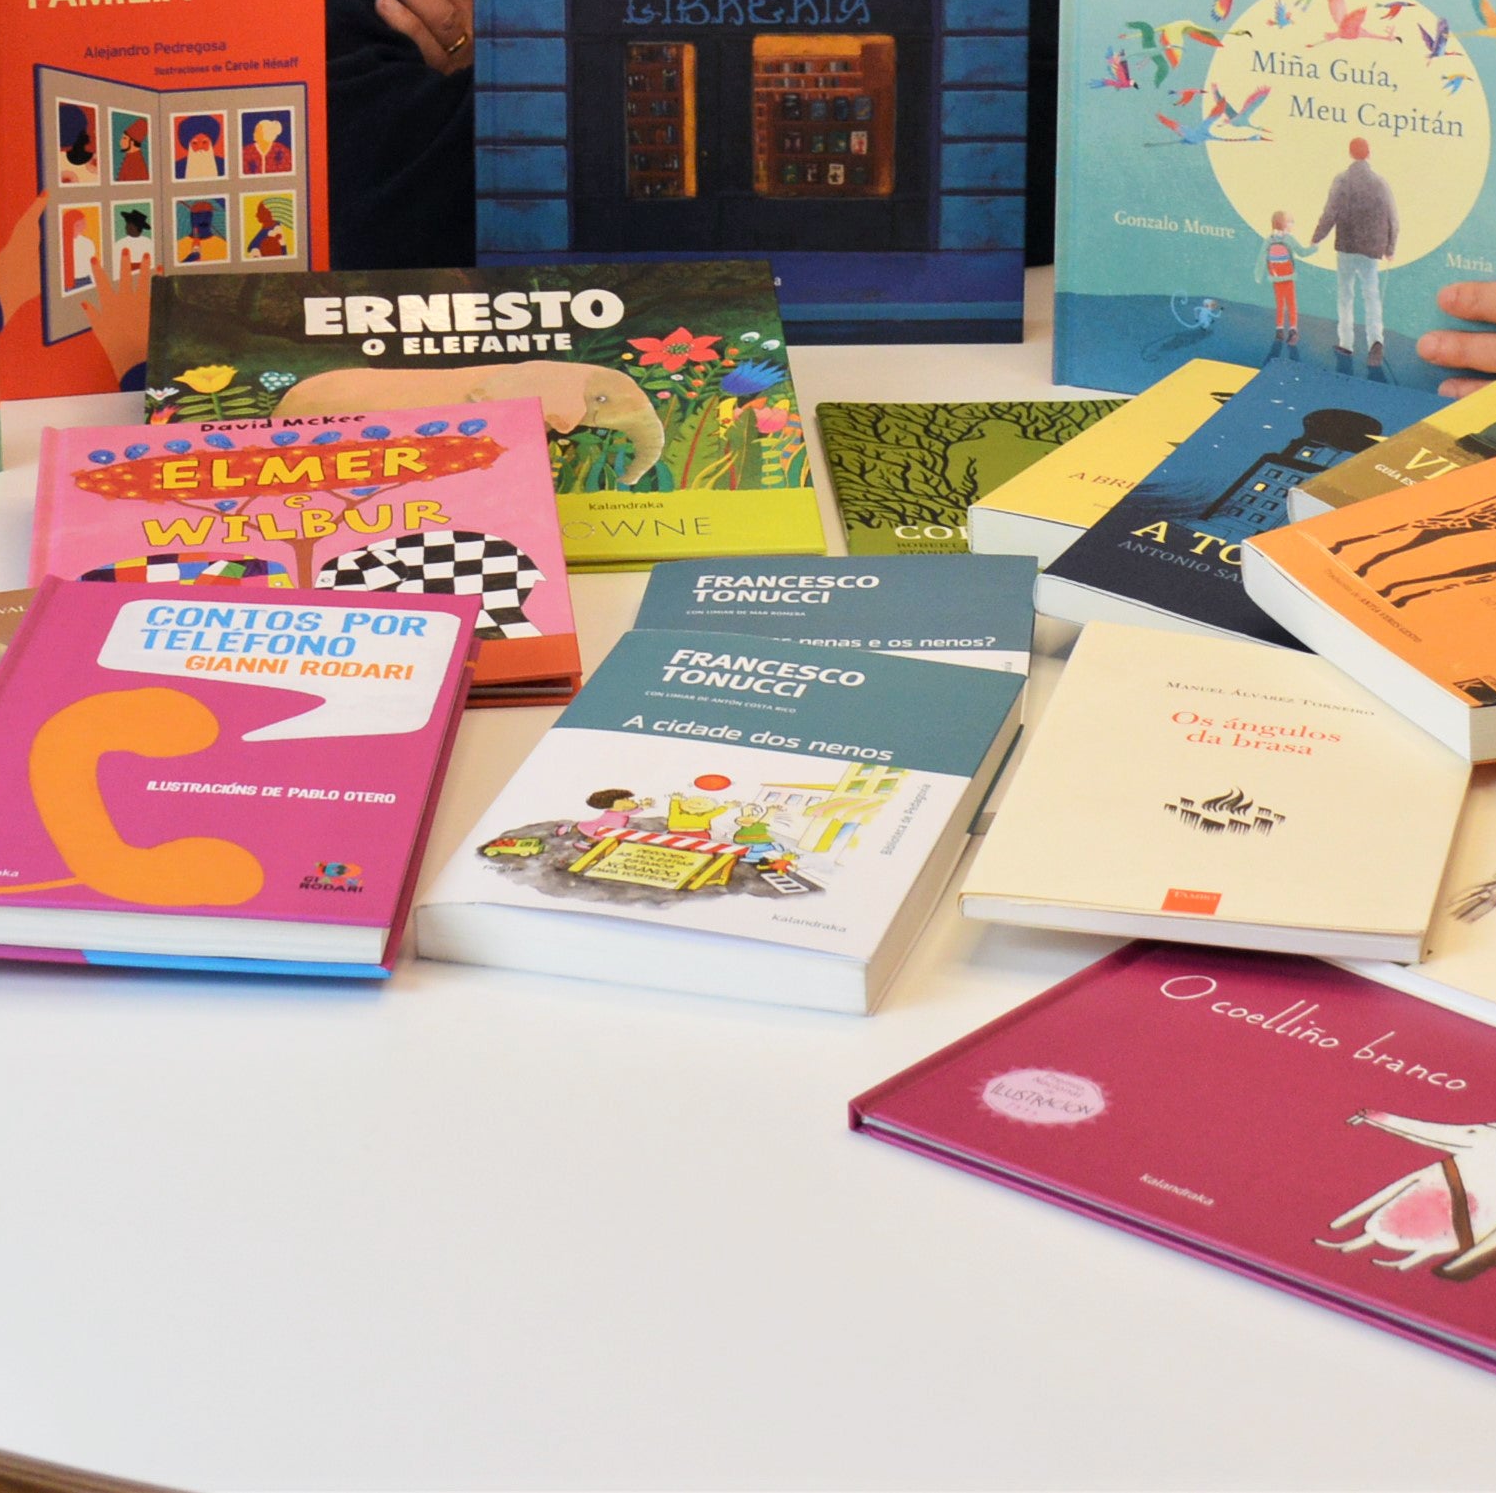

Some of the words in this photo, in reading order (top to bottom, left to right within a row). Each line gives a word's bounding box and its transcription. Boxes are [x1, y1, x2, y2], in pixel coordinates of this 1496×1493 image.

[84, 42, 149, 60] Alejandro
[154, 40, 227, 57] Pedregosa
[225, 60, 259, 71] Carole
[1250, 49, 1321, 80] Miña
[1330, 57, 1399, 91] Guía,
[1289, 95, 1348, 124] Meu
[1358, 102, 1464, 137] Capitán
[1114, 211, 1178, 234] Gonzalo
[1183, 217, 1236, 239] Moure
[303, 289, 624, 336] ERNESTO
[361, 338, 386, 356] O
[403, 333, 572, 355] ELEFANTE
[200, 420, 273, 433] David
[283, 412, 366, 429] McKee
[161, 446, 428, 490] ELMER
[1375, 463, 1402, 480] GUÍA
[1405, 446, 1461, 480] VI
[1068, 472, 1086, 481] A
[1091, 475, 1138, 490] BRI
[285, 493, 311, 508] e
[141, 500, 451, 548] WILBUR
[561, 517, 712, 541] OWNE
[1117, 540, 1211, 573] ANTONIO
[1130, 520, 1170, 544] A
[1189, 531, 1242, 566] TO
[692, 589, 830, 604] TONUCCI
[696, 576, 879, 589] FRANCESCO
[146, 606, 323, 633] CONTOS
[342, 613, 428, 638] POR
[139, 627, 357, 658] TELÉFONO
[799, 638, 862, 648] nenas
[869, 639, 882, 648] e
[888, 638, 912, 648] os
[920, 636, 996, 648] nenos?
[184, 656, 289, 675] GIANNI
[299, 658, 414, 680] RODARI
[662, 666, 807, 698] TONUCCI
[669, 649, 866, 687] FRANCESCO
[744, 701, 772, 710] COSTA
[774, 705, 797, 714] RICO
[1166, 681, 1225, 695] MANUEL
[1229, 688, 1295, 705] ÁLVAREZ
[1301, 697, 1376, 717] TORNEIRO
[623, 715, 645, 730] A
[653, 717, 740, 742] cidade
[749, 726, 802, 750] dos
[808, 738, 893, 762] nenos
[1171, 710, 1212, 728] Os
[1223, 716, 1341, 744] ángulos
[1185, 730, 1223, 746] da
[1233, 733, 1313, 757] brasa
[146, 779, 256, 797] ILUSTRACIÓNS
[262, 785, 283, 799] DE
[287, 786, 340, 801] PABLO
[344, 789, 396, 805] OTERO
[880, 824, 908, 856] Biblioteca
[299, 882, 364, 894] RODARI
[770, 913, 848, 935] kalandraka
[1158, 973, 1216, 1002] O
[1210, 997, 1341, 1053] coelliño
[1351, 1031, 1468, 1092] branco
[990, 1082, 1094, 1115] ILUSTRACIÓN
[1139, 1173, 1214, 1206] kalandraka
